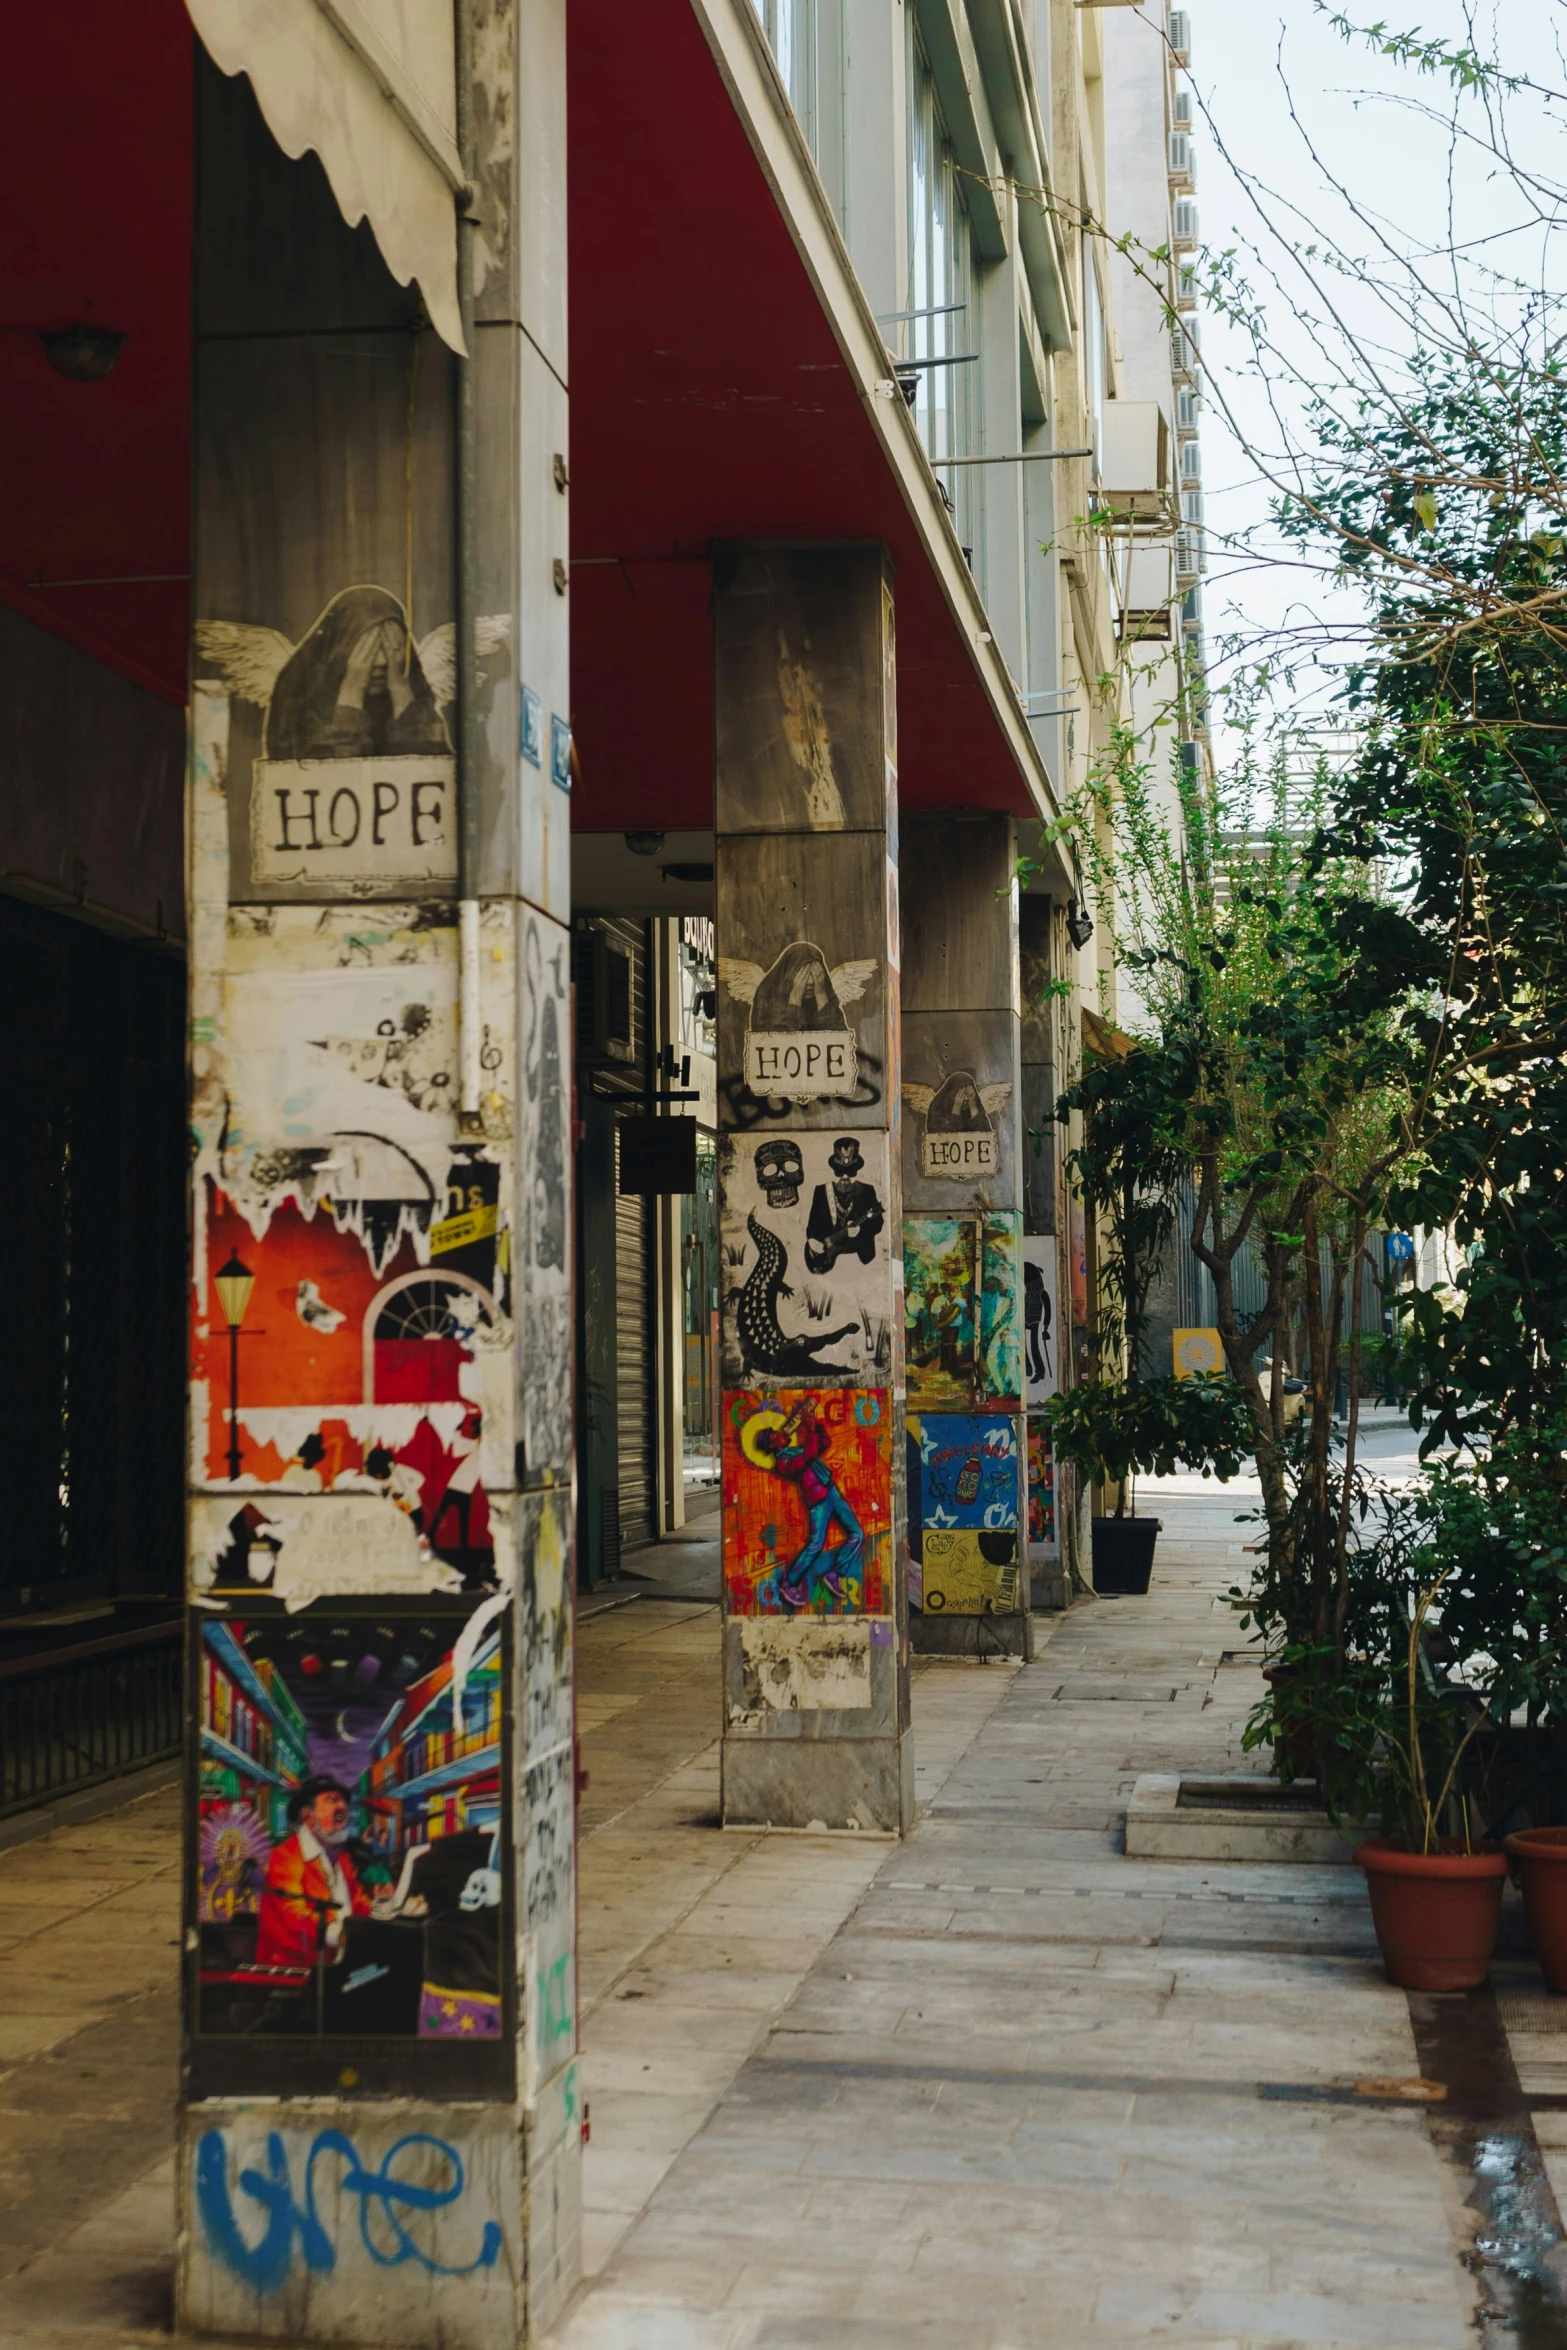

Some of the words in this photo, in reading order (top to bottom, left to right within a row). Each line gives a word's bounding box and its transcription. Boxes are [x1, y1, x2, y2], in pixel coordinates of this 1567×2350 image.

[275, 781, 446, 851] HOPE
[756, 1044, 845, 1079] HOPE
[930, 1140, 991, 1165] HOPE
